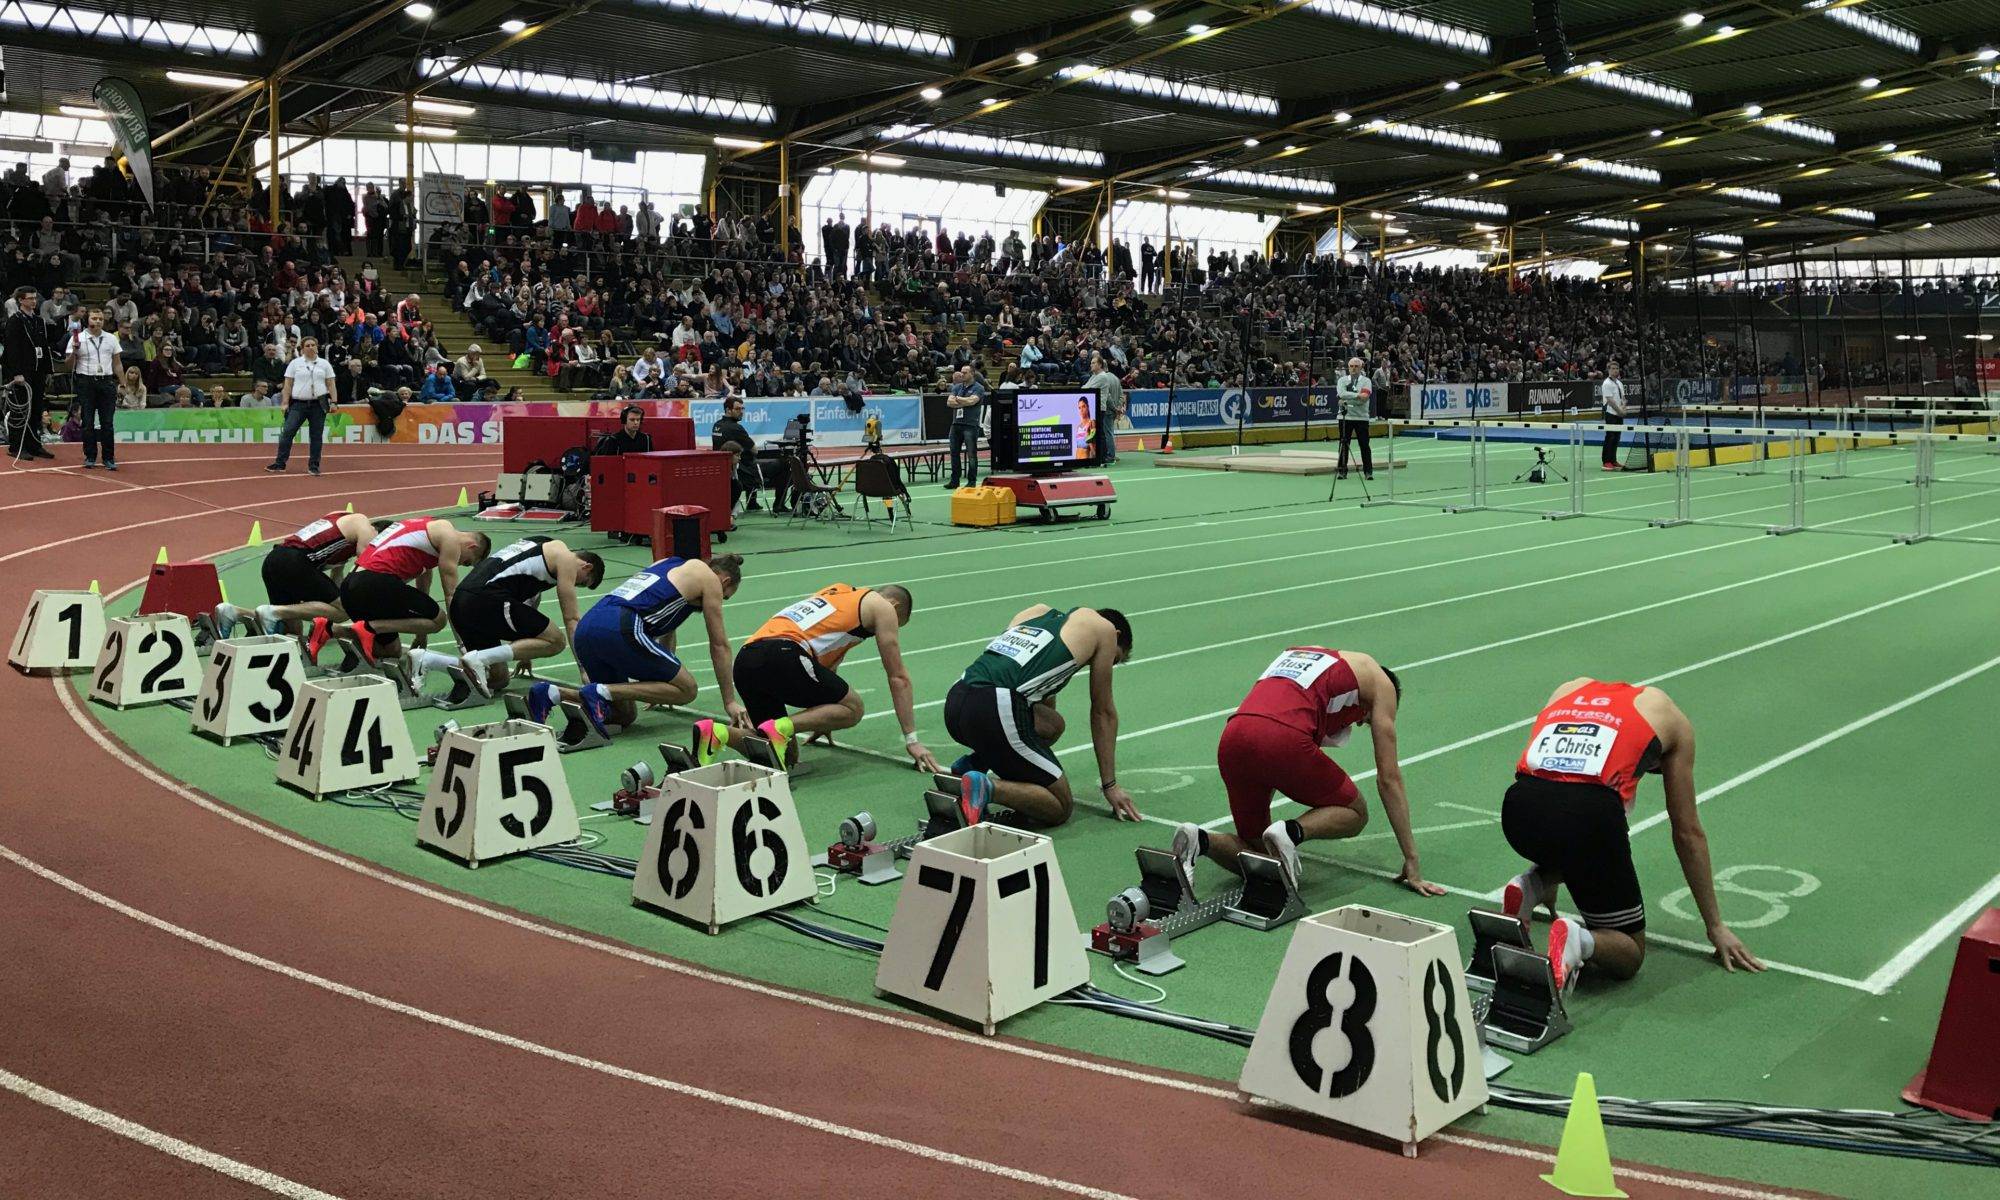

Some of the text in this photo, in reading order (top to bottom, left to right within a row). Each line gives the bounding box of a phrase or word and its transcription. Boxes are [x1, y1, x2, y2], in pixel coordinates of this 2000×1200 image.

[745, 408, 771, 424] nah.
[1131, 404, 1157, 417] KINDER
[1421, 389, 1448, 410] DKB
[1465, 388, 1491, 408] DKB
[1528, 389, 1563, 405] RUNNING
[418, 421, 474, 443] DAS
[19, 601, 39, 656] 1
[58, 603, 82, 660] 1
[97, 631, 123, 694] 2
[138, 629, 185, 694] 2
[203, 653, 231, 722] 3
[248, 653, 294, 723] 3
[1275, 659, 1312, 671] Rust
[1573, 695, 1611, 706] LG
[1576, 725, 1596, 734] GLS
[289, 698, 316, 776] 4
[341, 698, 393, 775] 4
[1538, 736, 1602, 757] F. Christ
[1559, 758, 1585, 768] PLAN
[435, 747, 475, 839] 5
[498, 745, 553, 839] 5
[657, 797, 706, 900] 6
[732, 796, 789, 898] 6
[917, 864, 976, 992] 7
[997, 861, 1050, 989] 7
[1660, 864, 1822, 929] 8
[1289, 951, 1377, 1099] 8
[1423, 957, 1465, 1104] 8
